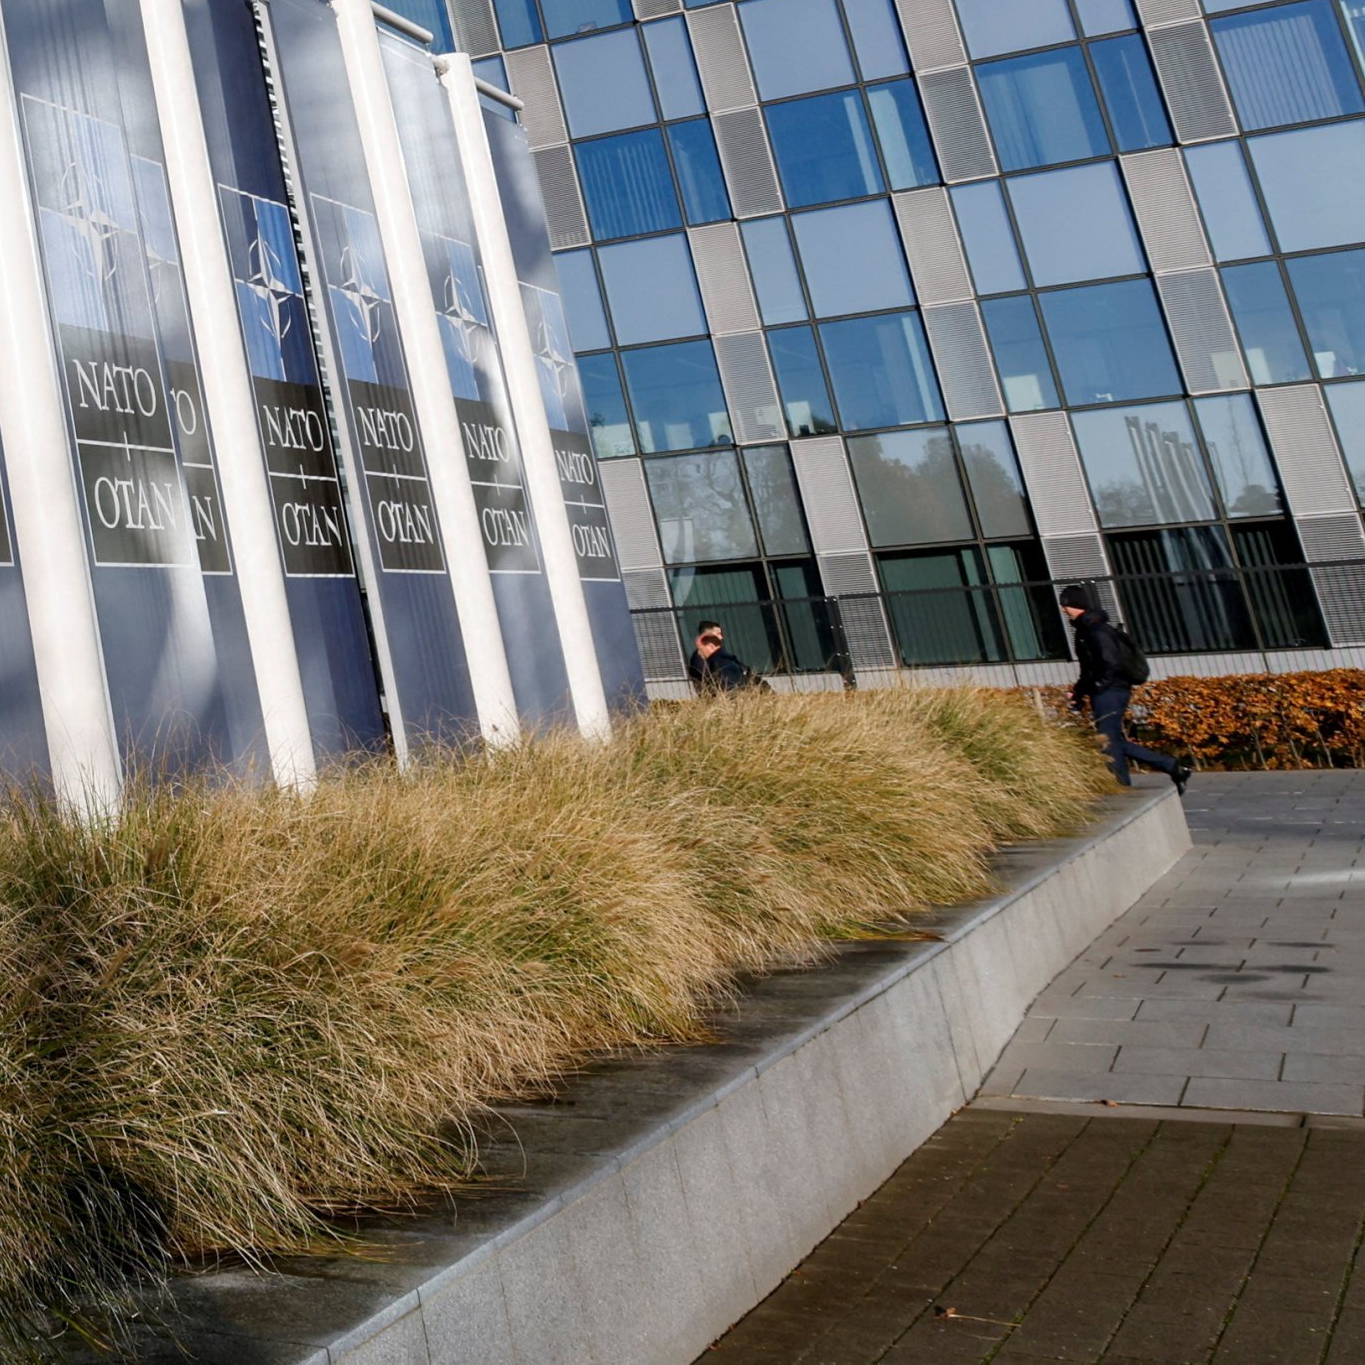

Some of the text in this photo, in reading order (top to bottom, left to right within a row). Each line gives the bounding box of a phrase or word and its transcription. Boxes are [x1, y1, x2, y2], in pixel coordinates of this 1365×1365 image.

[73, 359, 156, 417] NATO
[263, 405, 324, 451] NATO
[357, 406, 414, 452] NATO
[462, 422, 510, 463] NATO
[556, 449, 594, 486] NATO
[95, 476, 177, 532] OTAN
[282, 502, 342, 547] OTAN
[378, 500, 434, 545] OTAN
[482, 507, 529, 547] OTAN
[571, 522, 611, 559] OTAN
